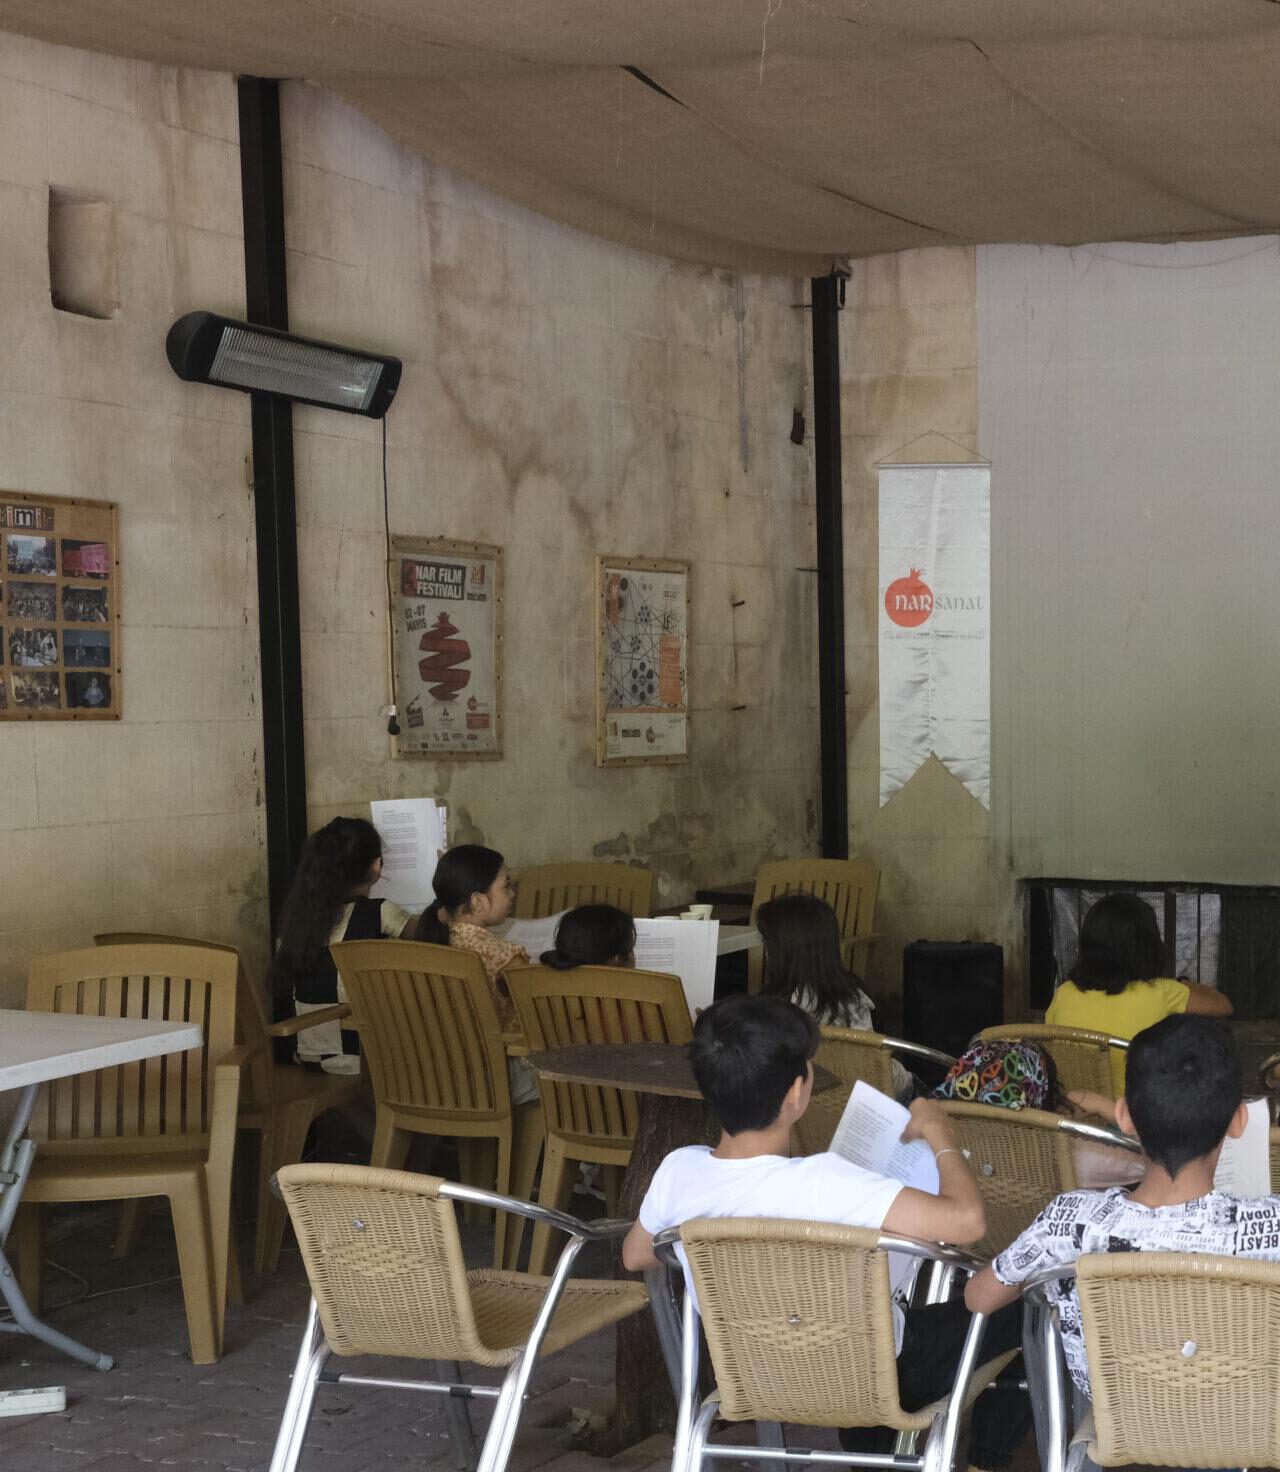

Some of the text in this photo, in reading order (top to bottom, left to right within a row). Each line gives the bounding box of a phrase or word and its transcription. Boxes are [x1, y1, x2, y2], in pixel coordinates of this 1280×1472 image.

[416, 566, 436, 581] NAR
[1239, 1206, 1277, 1222] TODAY
[1241, 1219, 1280, 1236] FEAST
[1239, 1234, 1279, 1252] BEAST
